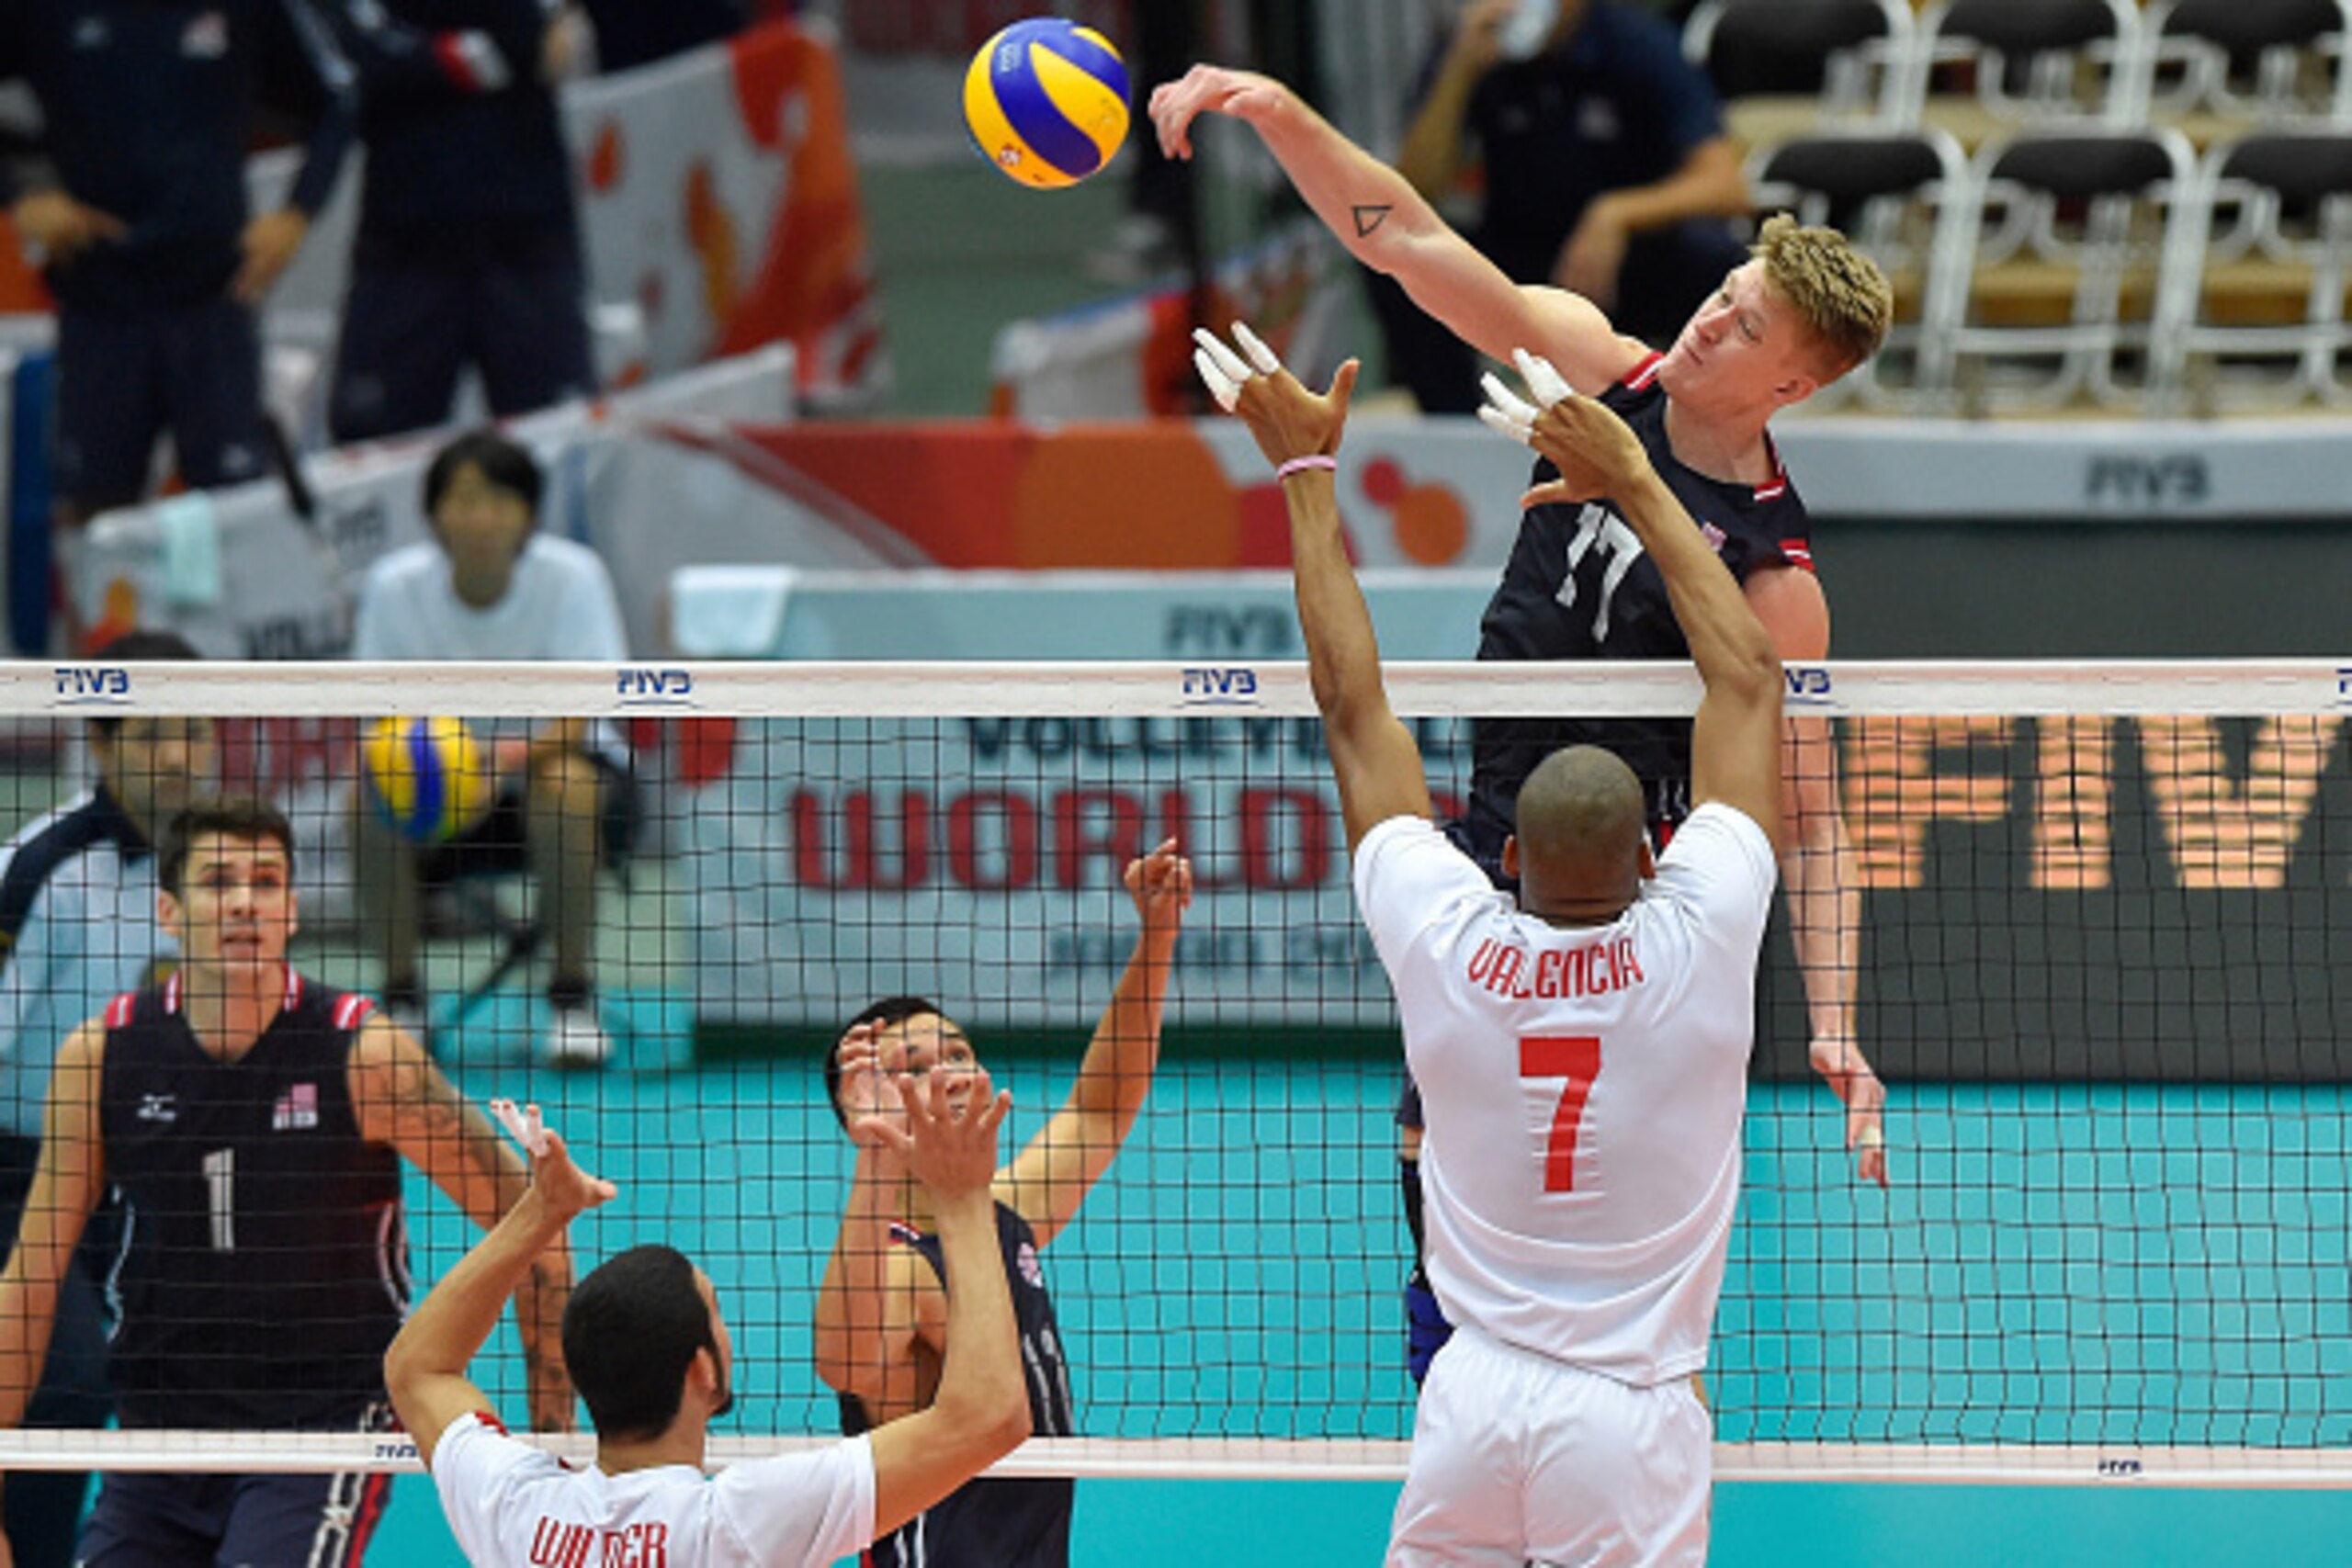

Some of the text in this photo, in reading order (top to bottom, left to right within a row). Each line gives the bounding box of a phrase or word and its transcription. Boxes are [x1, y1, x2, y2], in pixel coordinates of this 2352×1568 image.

[1555, 502, 1645, 643] 17
[54, 667, 130, 694] FIVB
[616, 668, 691, 694] FIVB
[1182, 668, 1257, 694] FIVB
[1784, 668, 1831, 694] VB
[790, 788, 1330, 890] WORLD
[1467, 937, 1645, 999] VALENCIA
[1520, 1035, 1601, 1193] 7
[202, 1147, 235, 1252] 1
